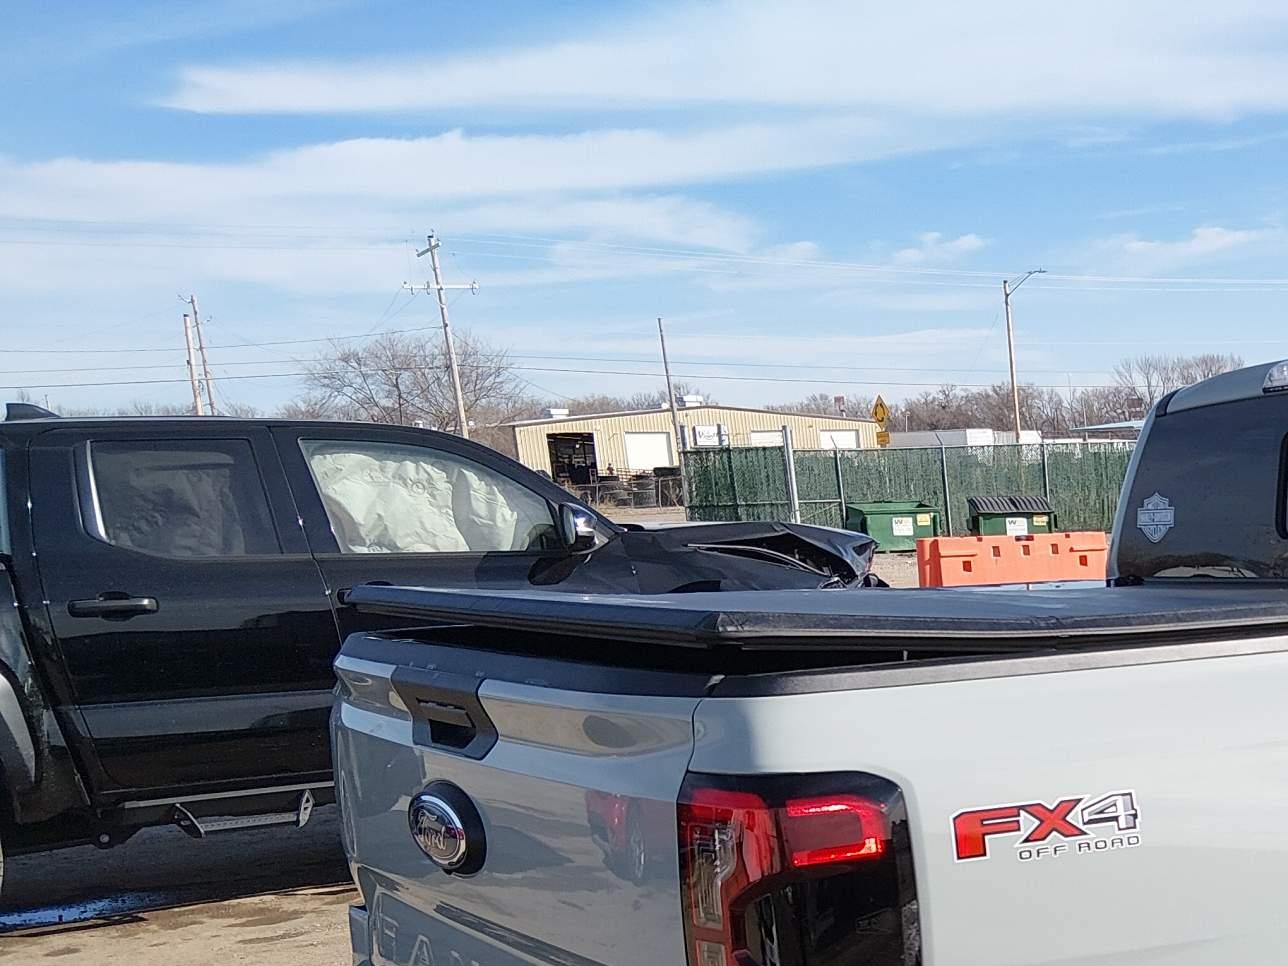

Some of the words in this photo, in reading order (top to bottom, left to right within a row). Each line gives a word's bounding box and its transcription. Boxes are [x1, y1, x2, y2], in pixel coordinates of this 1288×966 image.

[951, 790, 1139, 861] FX4
[1018, 845, 1068, 861] OFF
[1077, 835, 1141, 854] ROAD
